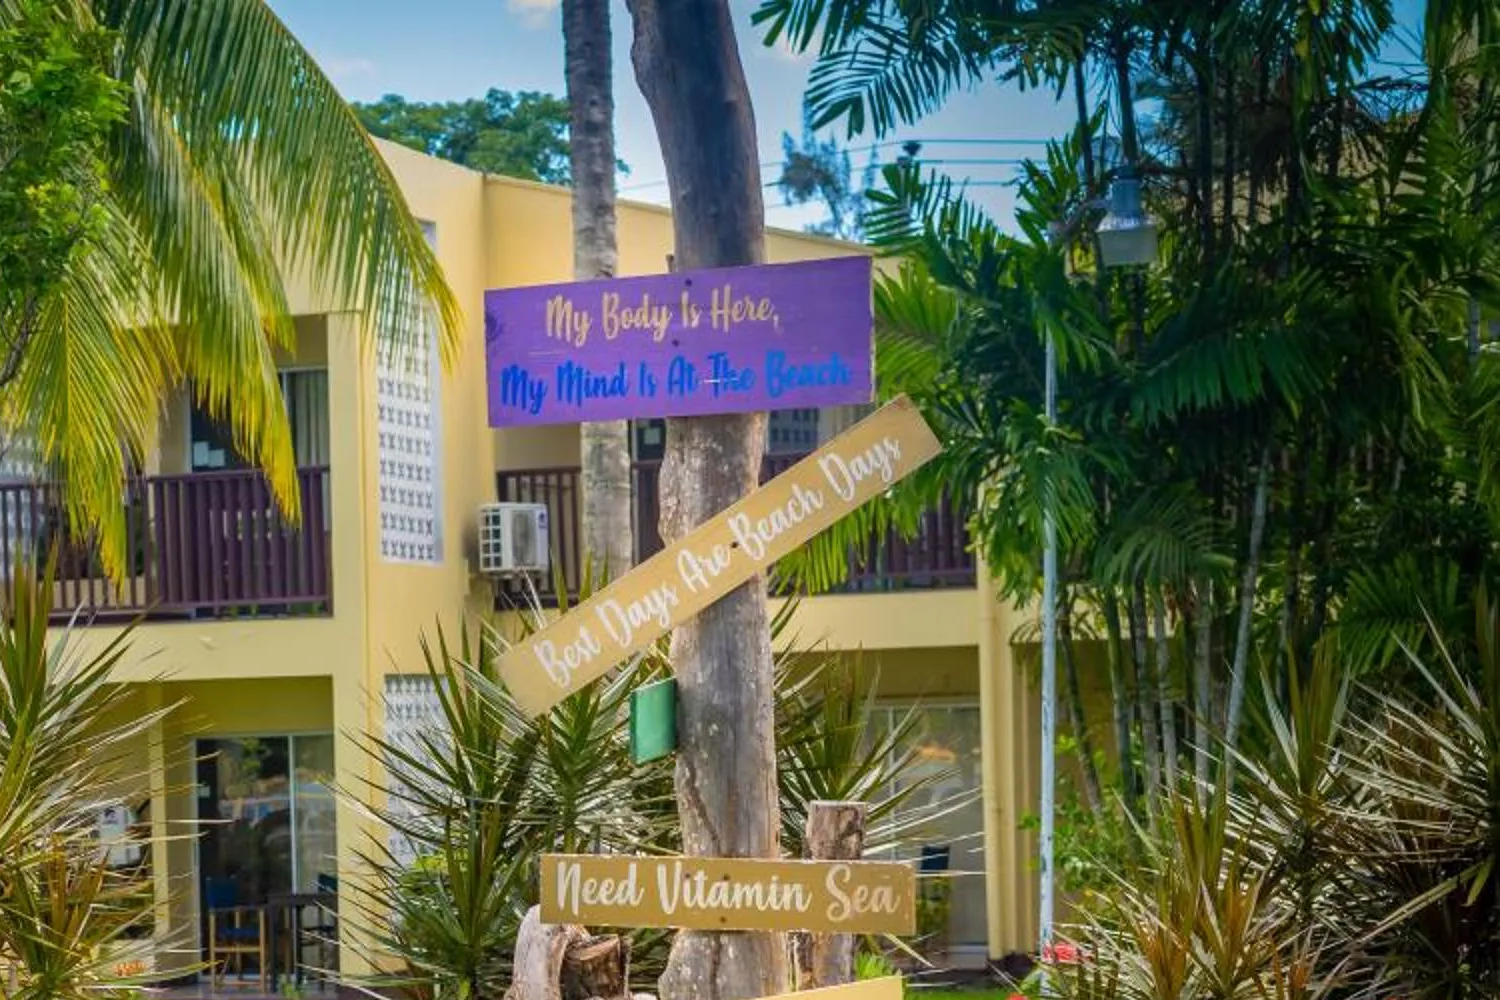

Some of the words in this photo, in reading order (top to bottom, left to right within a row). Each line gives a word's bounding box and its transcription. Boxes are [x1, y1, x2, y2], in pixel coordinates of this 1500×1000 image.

[545, 294, 592, 347] My
[601, 291, 672, 343] Body
[682, 289, 700, 327] Is
[712, 284, 781, 332] Here,
[502, 363, 548, 415] My
[556, 358, 629, 408] Mind
[639, 361, 657, 396] Is
[667, 355, 698, 395] At
[707, 351, 756, 397] The
[765, 350, 853, 397] Beach
[533, 630, 600, 688] Best
[595, 584, 679, 648] Days
[676, 549, 733, 594] Are
[729, 482, 827, 562] Beach
[817, 435, 902, 501] Days
[556, 861, 644, 916] Need
[656, 860, 812, 915] Vitamin
[825, 864, 899, 922] Sea
